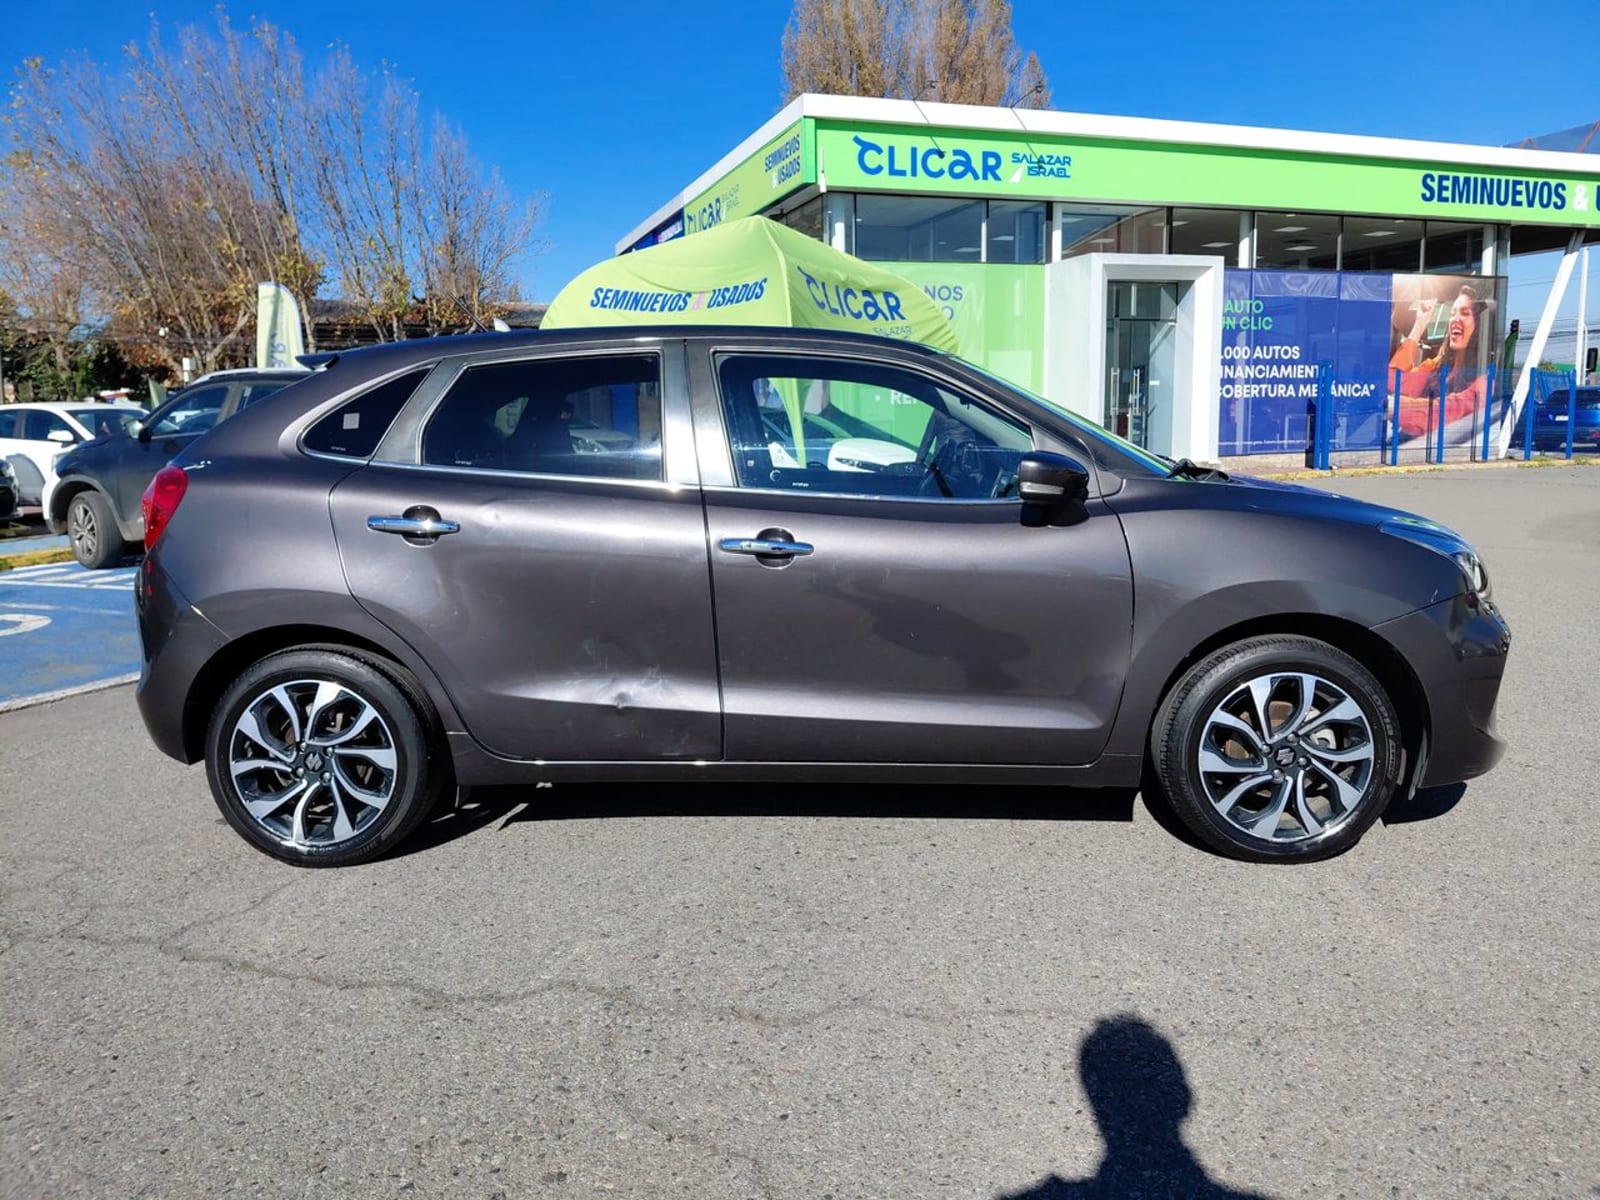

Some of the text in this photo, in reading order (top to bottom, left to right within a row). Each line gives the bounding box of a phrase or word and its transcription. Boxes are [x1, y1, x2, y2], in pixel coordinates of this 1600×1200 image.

[1011, 152, 1071, 167] SALAZAR
[1027, 165, 1071, 178] ISRAEL
[1421, 173, 1567, 210] SEMINUEVOS
[1572, 184, 1589, 211] &
[590, 287, 692, 312] SEMINUEVOS
[707, 277, 768, 309] USADOS
[1224, 300, 1264, 314] AUTO
[1240, 316, 1273, 330] CLIC
[1253, 346, 1300, 360] AUTOS
[1219, 379, 1375, 398] OBERTURA MEÁNICA
